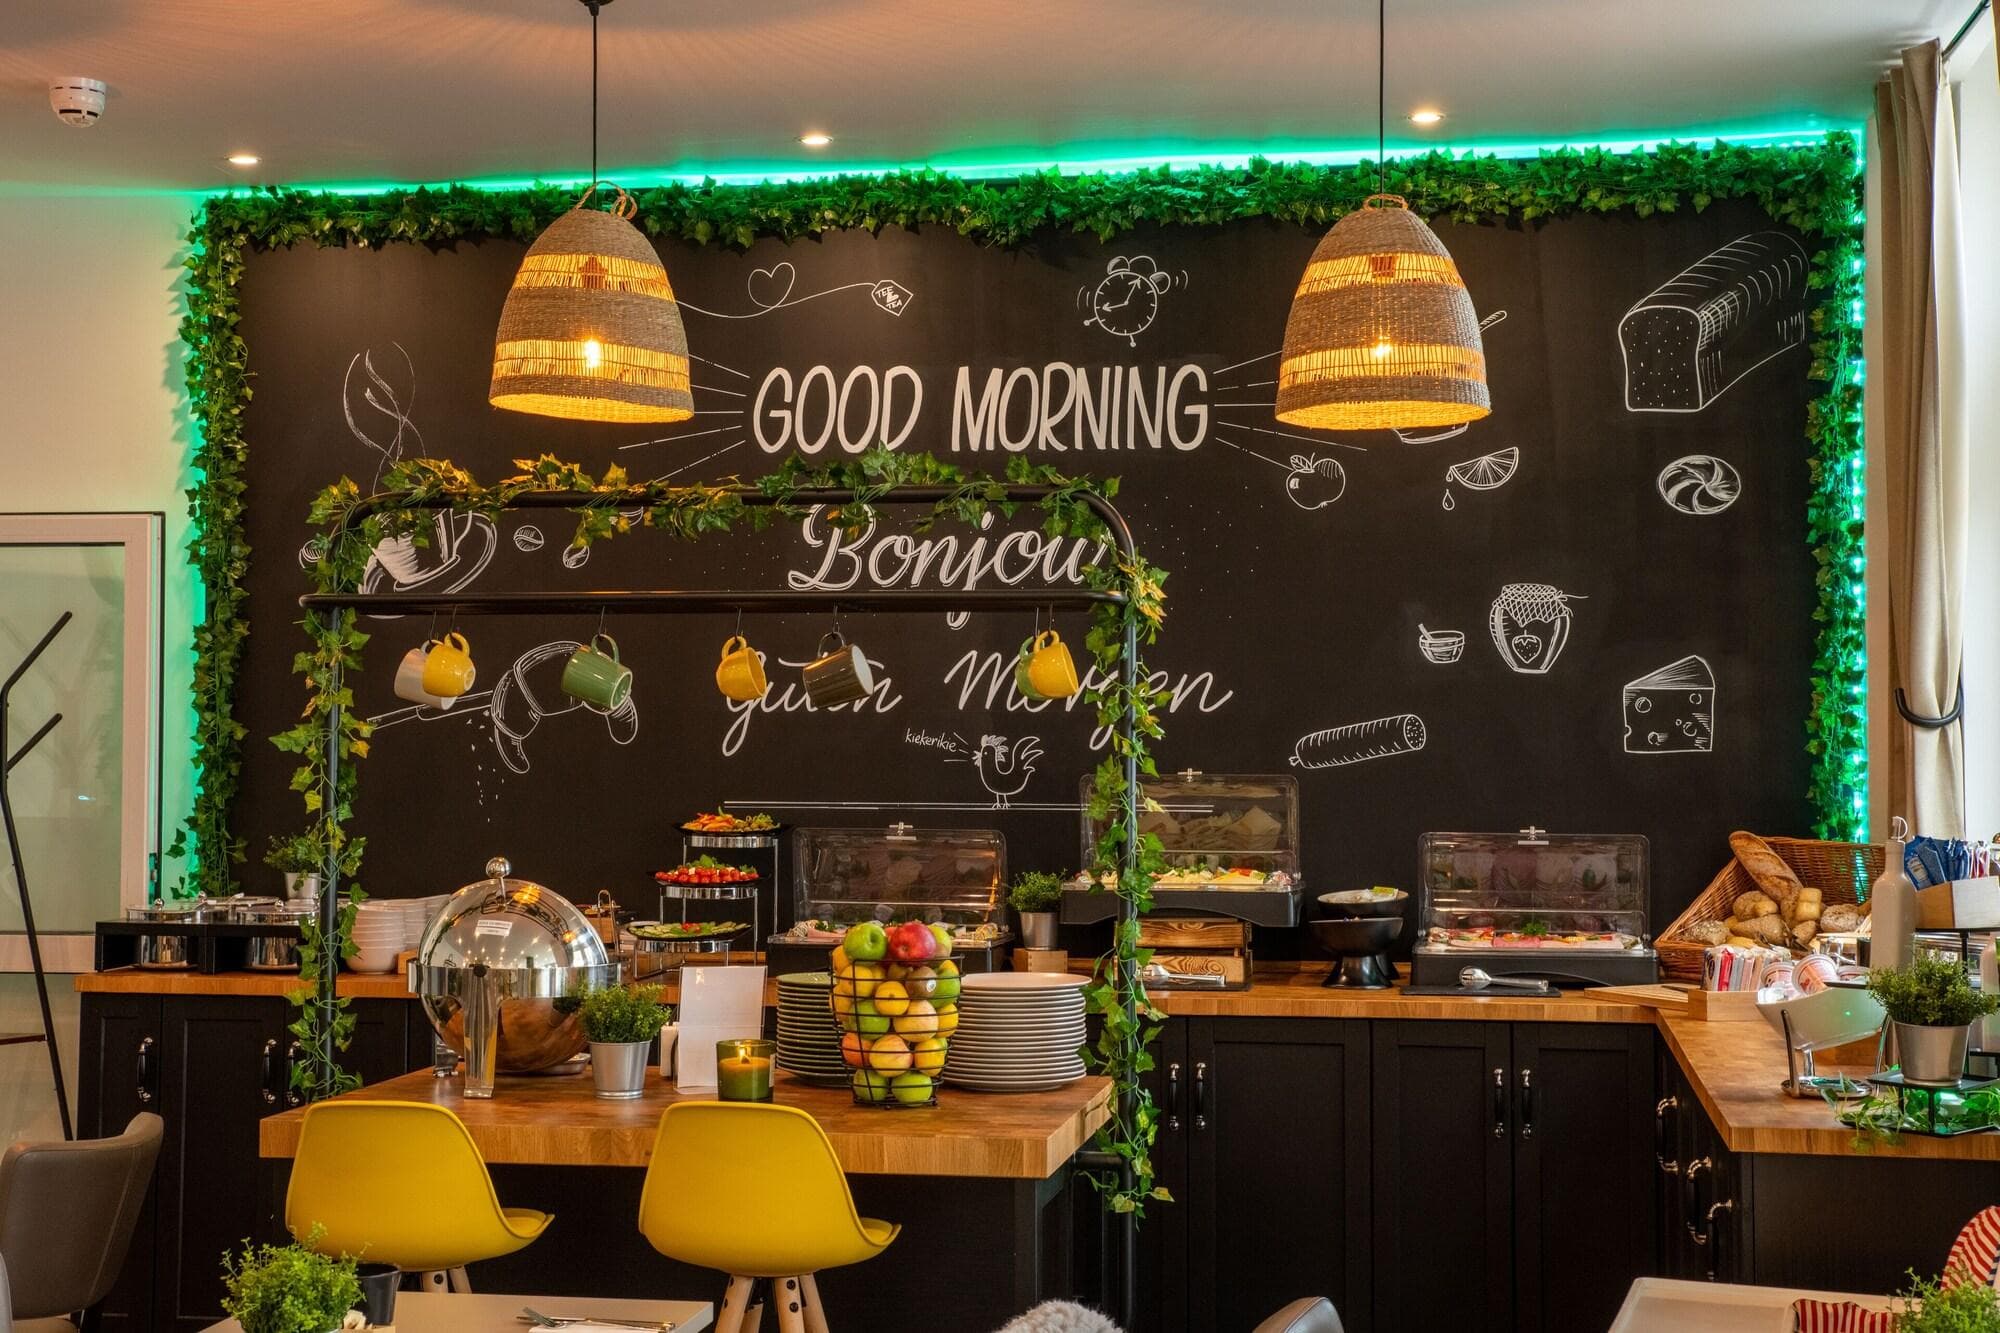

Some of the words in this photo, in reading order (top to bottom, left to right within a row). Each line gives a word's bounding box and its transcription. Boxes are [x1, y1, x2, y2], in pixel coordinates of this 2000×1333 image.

[875, 285, 894, 299] TEE
[885, 299, 903, 309] TEA
[753, 365, 923, 453] GOOD
[951, 362, 1208, 452] MORNING
[788, 502, 1109, 630] Bonjou
